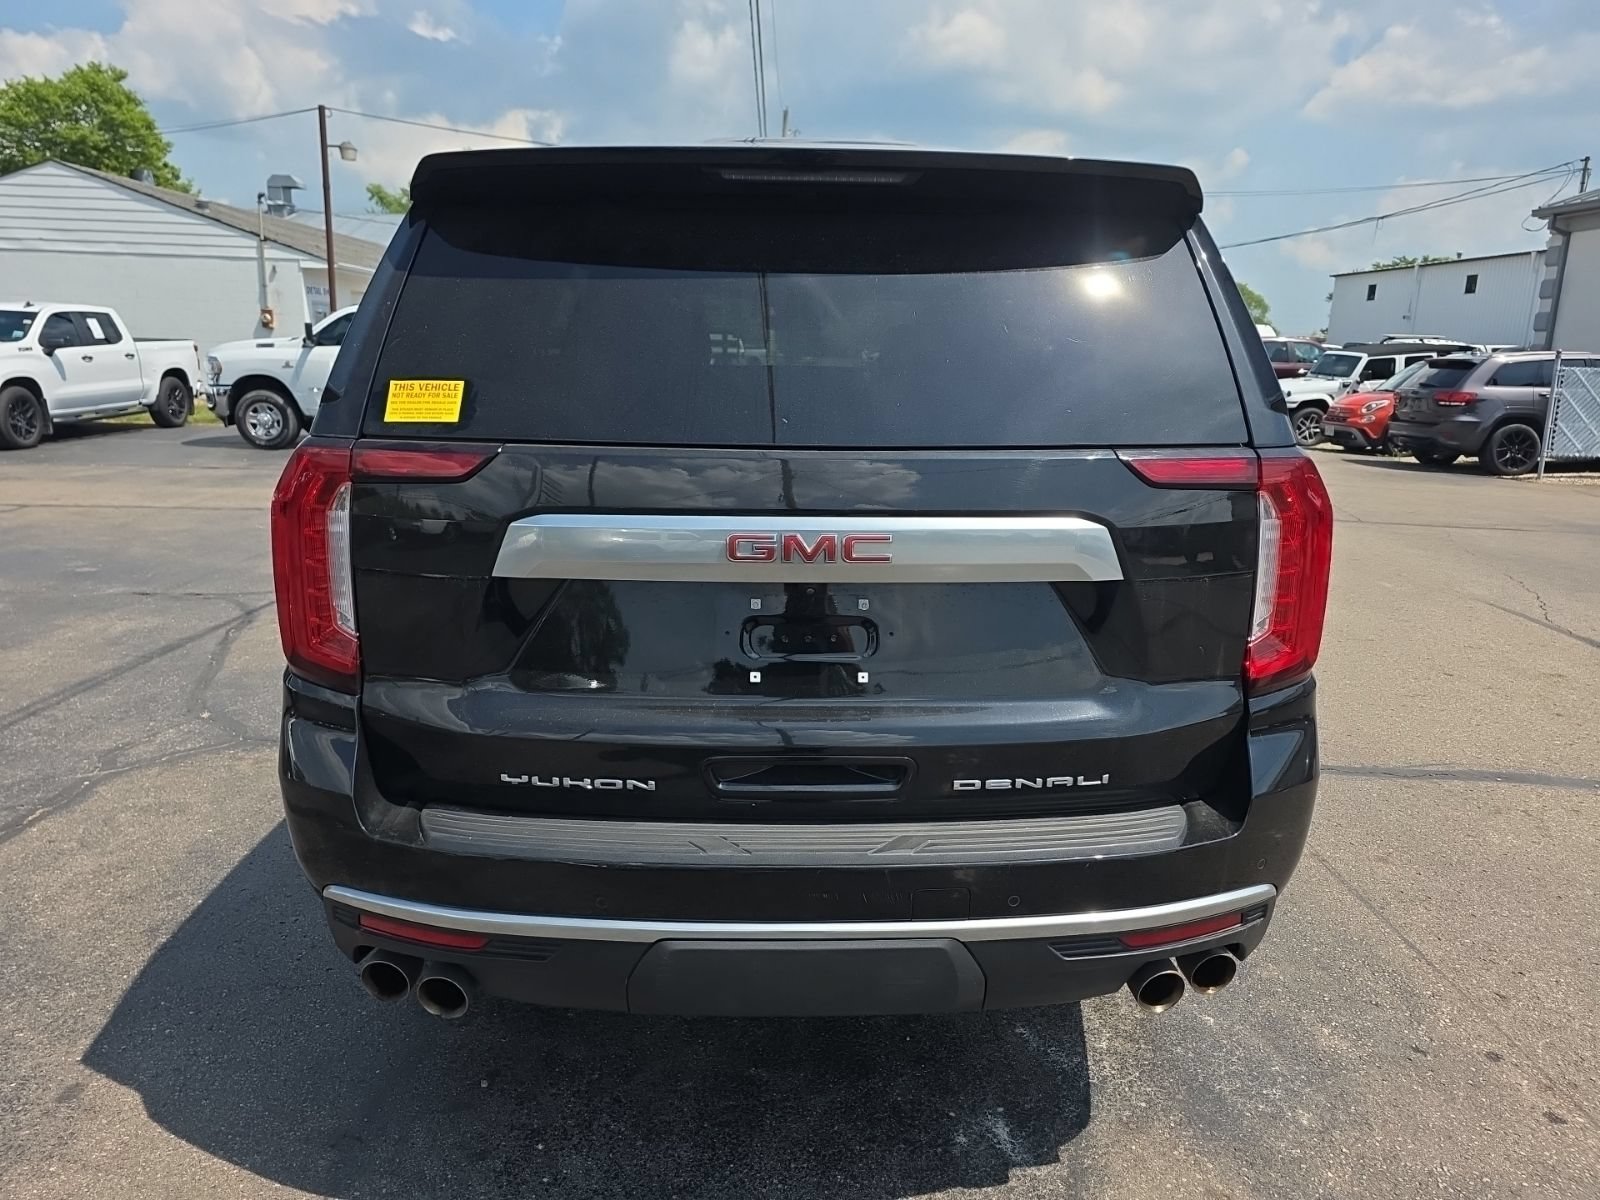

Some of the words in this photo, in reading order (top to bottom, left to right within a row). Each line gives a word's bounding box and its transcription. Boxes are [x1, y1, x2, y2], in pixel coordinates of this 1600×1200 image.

[393, 383, 415, 391] THIS
[418, 383, 461, 391] VEHICLE
[726, 533, 892, 563] GMC
[500, 773, 656, 791] YUKON
[953, 773, 1110, 791] DENALI
